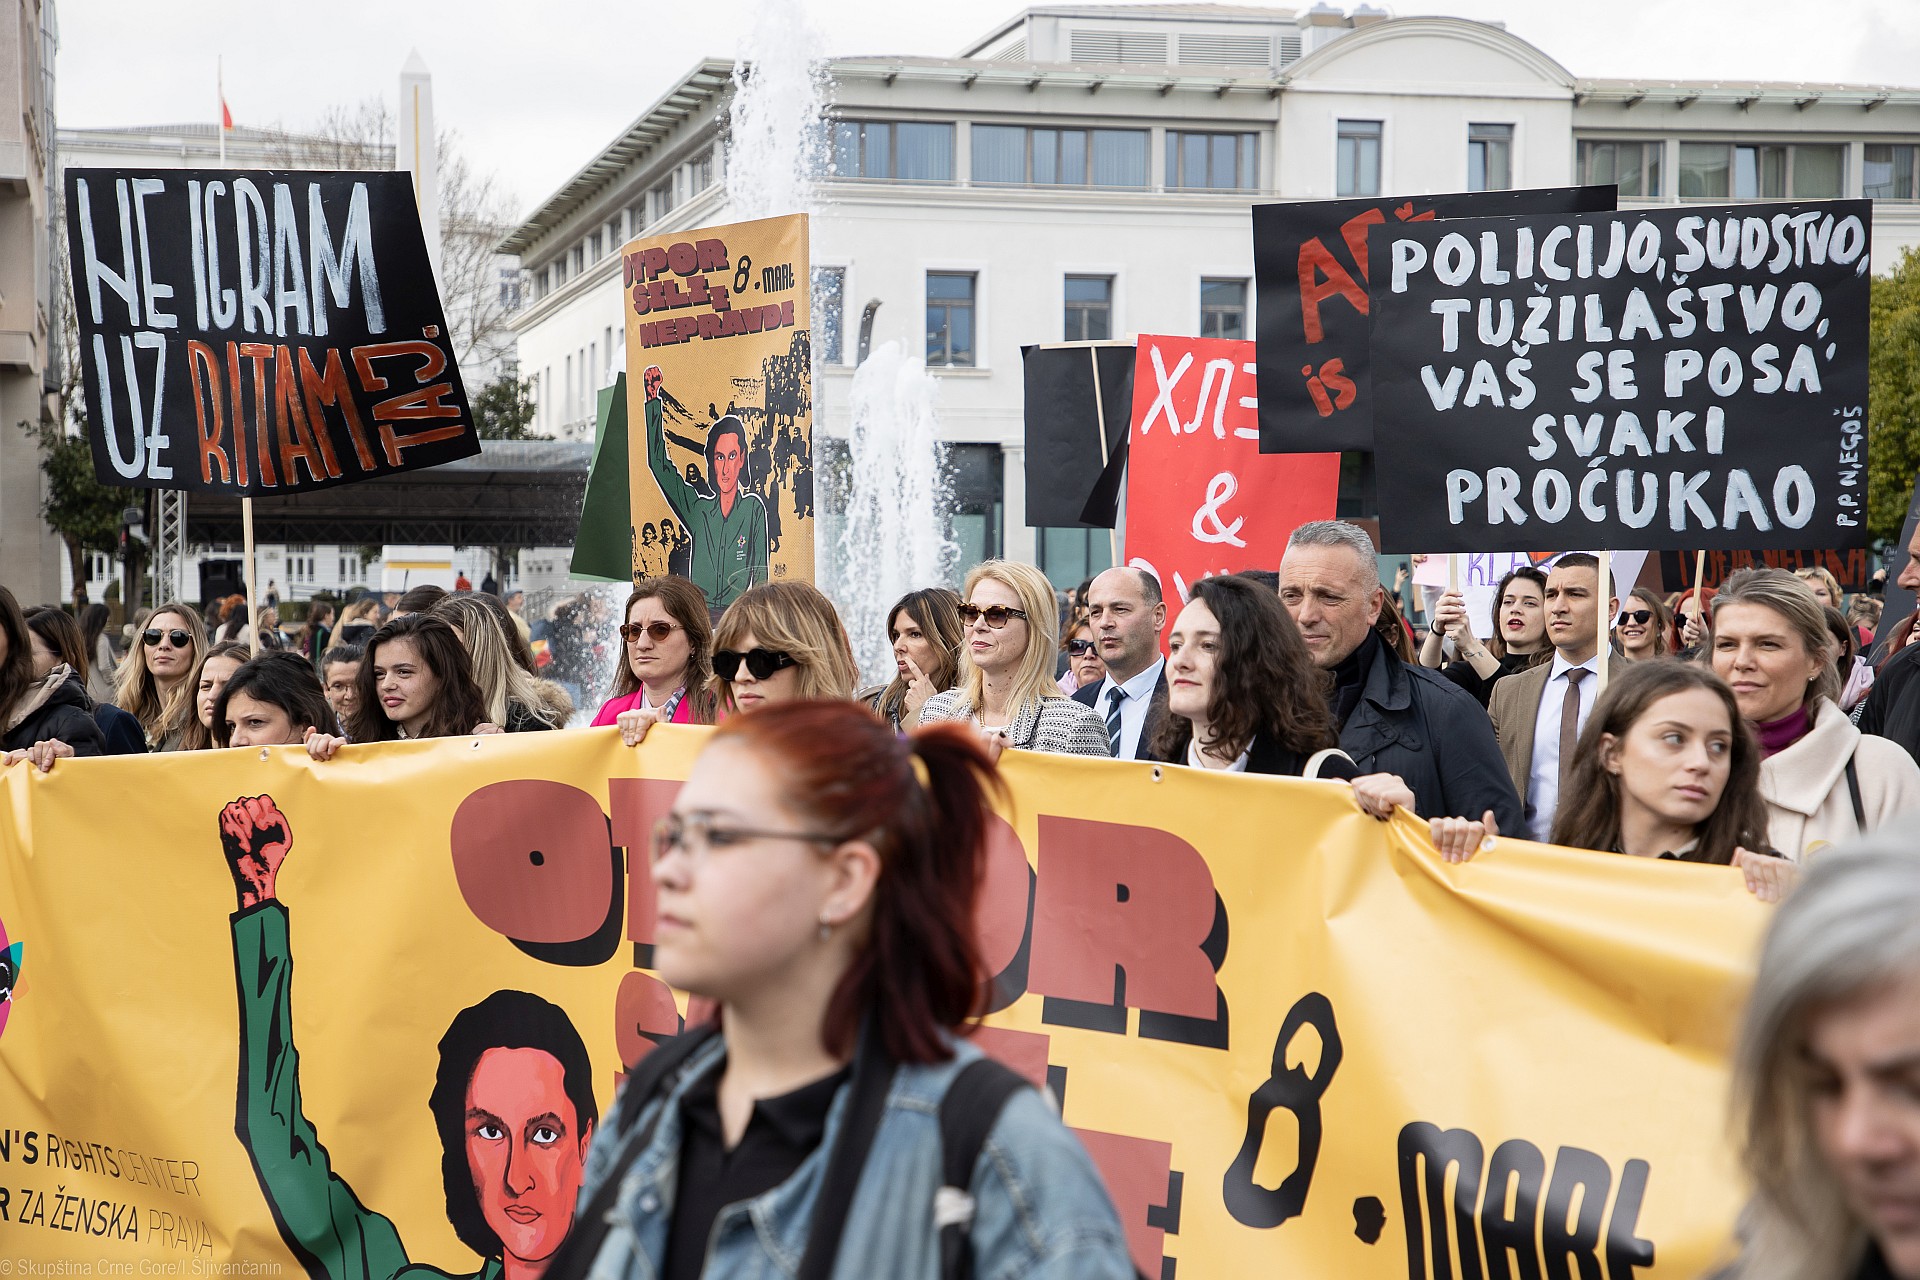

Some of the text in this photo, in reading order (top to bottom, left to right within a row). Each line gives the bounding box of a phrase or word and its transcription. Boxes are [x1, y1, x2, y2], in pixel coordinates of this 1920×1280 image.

[77, 177, 387, 337] NE IGRAM
[1391, 219, 1666, 293] POLICIJO,
[1675, 211, 1870, 279] SUDSTVO,
[633, 275, 712, 315] SILI
[640, 300, 794, 349] NEPRAVDI
[1430, 271, 1830, 353] TUŽILAŠTVO,
[188, 339, 377, 487] RITAM
[1420, 341, 1536, 411] VAŠ
[1570, 348, 1639, 404] SE
[1528, 405, 1725, 461] SVAKI
[1190, 470, 1248, 549] &
[1446, 456, 1816, 532] PROĆUKAO
[19, 1189, 44, 1226] ZA
[50, 1184, 138, 1242] ŽENSKA
[147, 1209, 213, 1257] PRAVA
